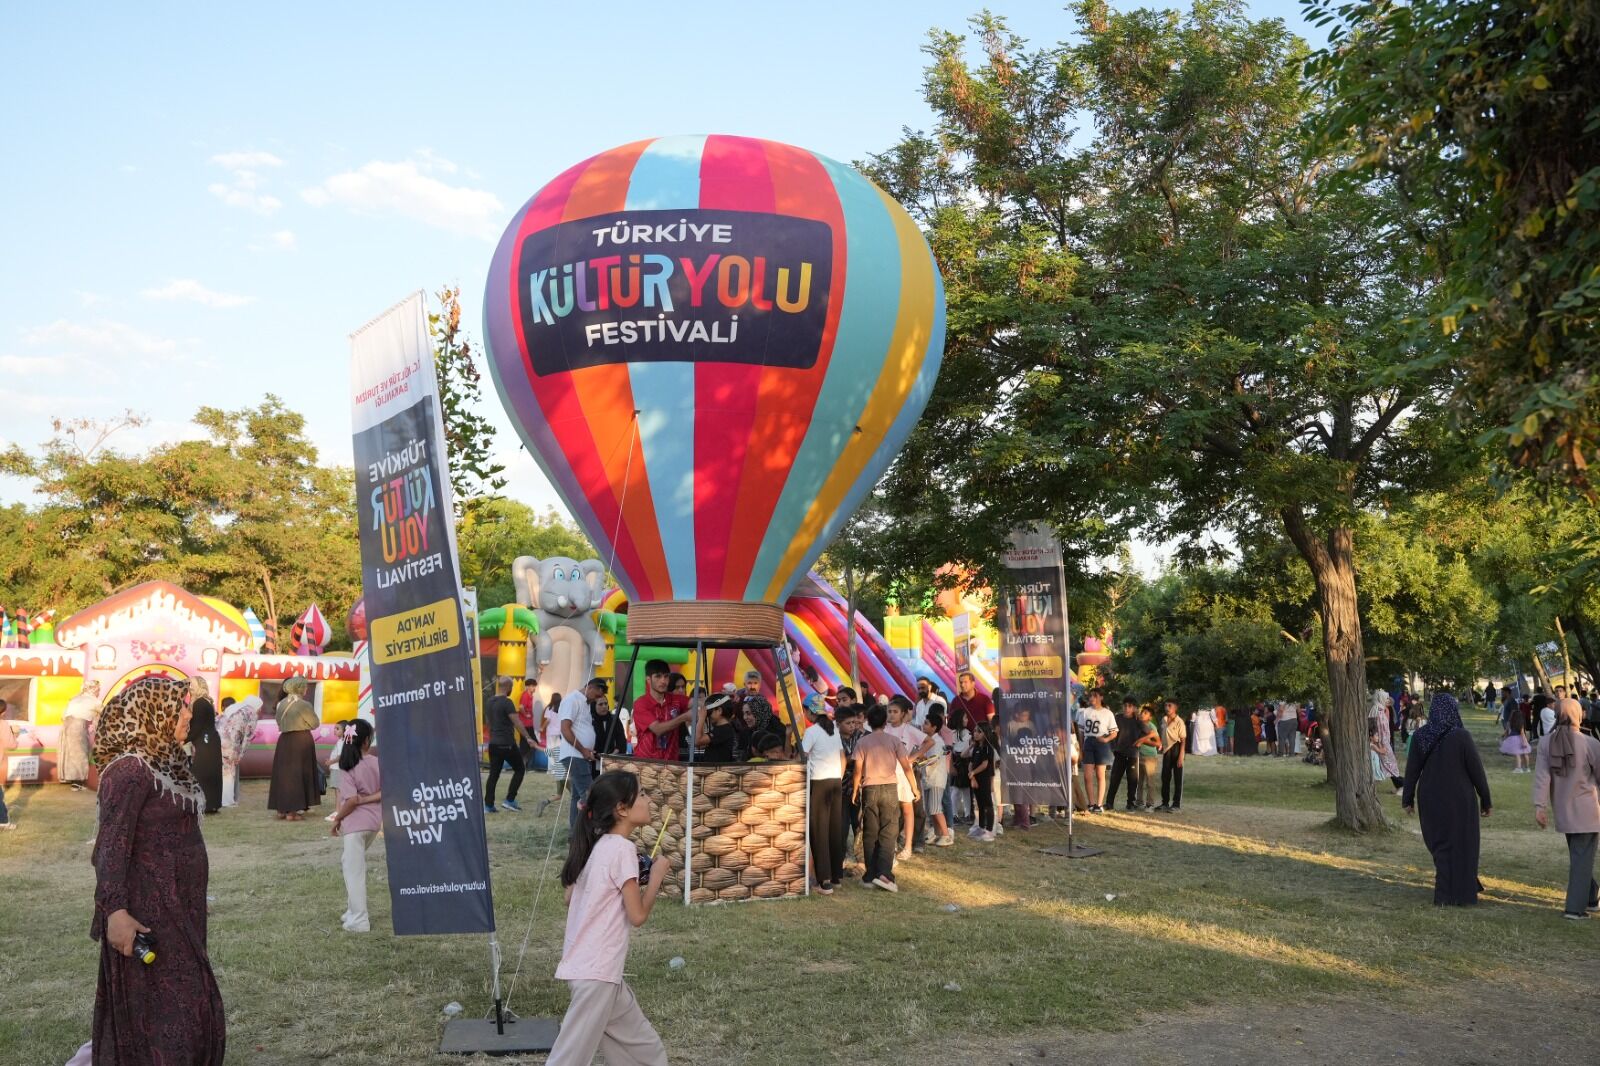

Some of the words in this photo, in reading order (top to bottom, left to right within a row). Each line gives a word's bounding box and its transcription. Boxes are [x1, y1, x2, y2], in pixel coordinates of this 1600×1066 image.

[592, 218, 733, 246] TÜRKİYE
[530, 254, 675, 326] KÜLTÜR
[679, 254, 813, 314] YOLU
[585, 313, 739, 348] FESTİVALİ
[1085, 719, 1101, 734] 96
